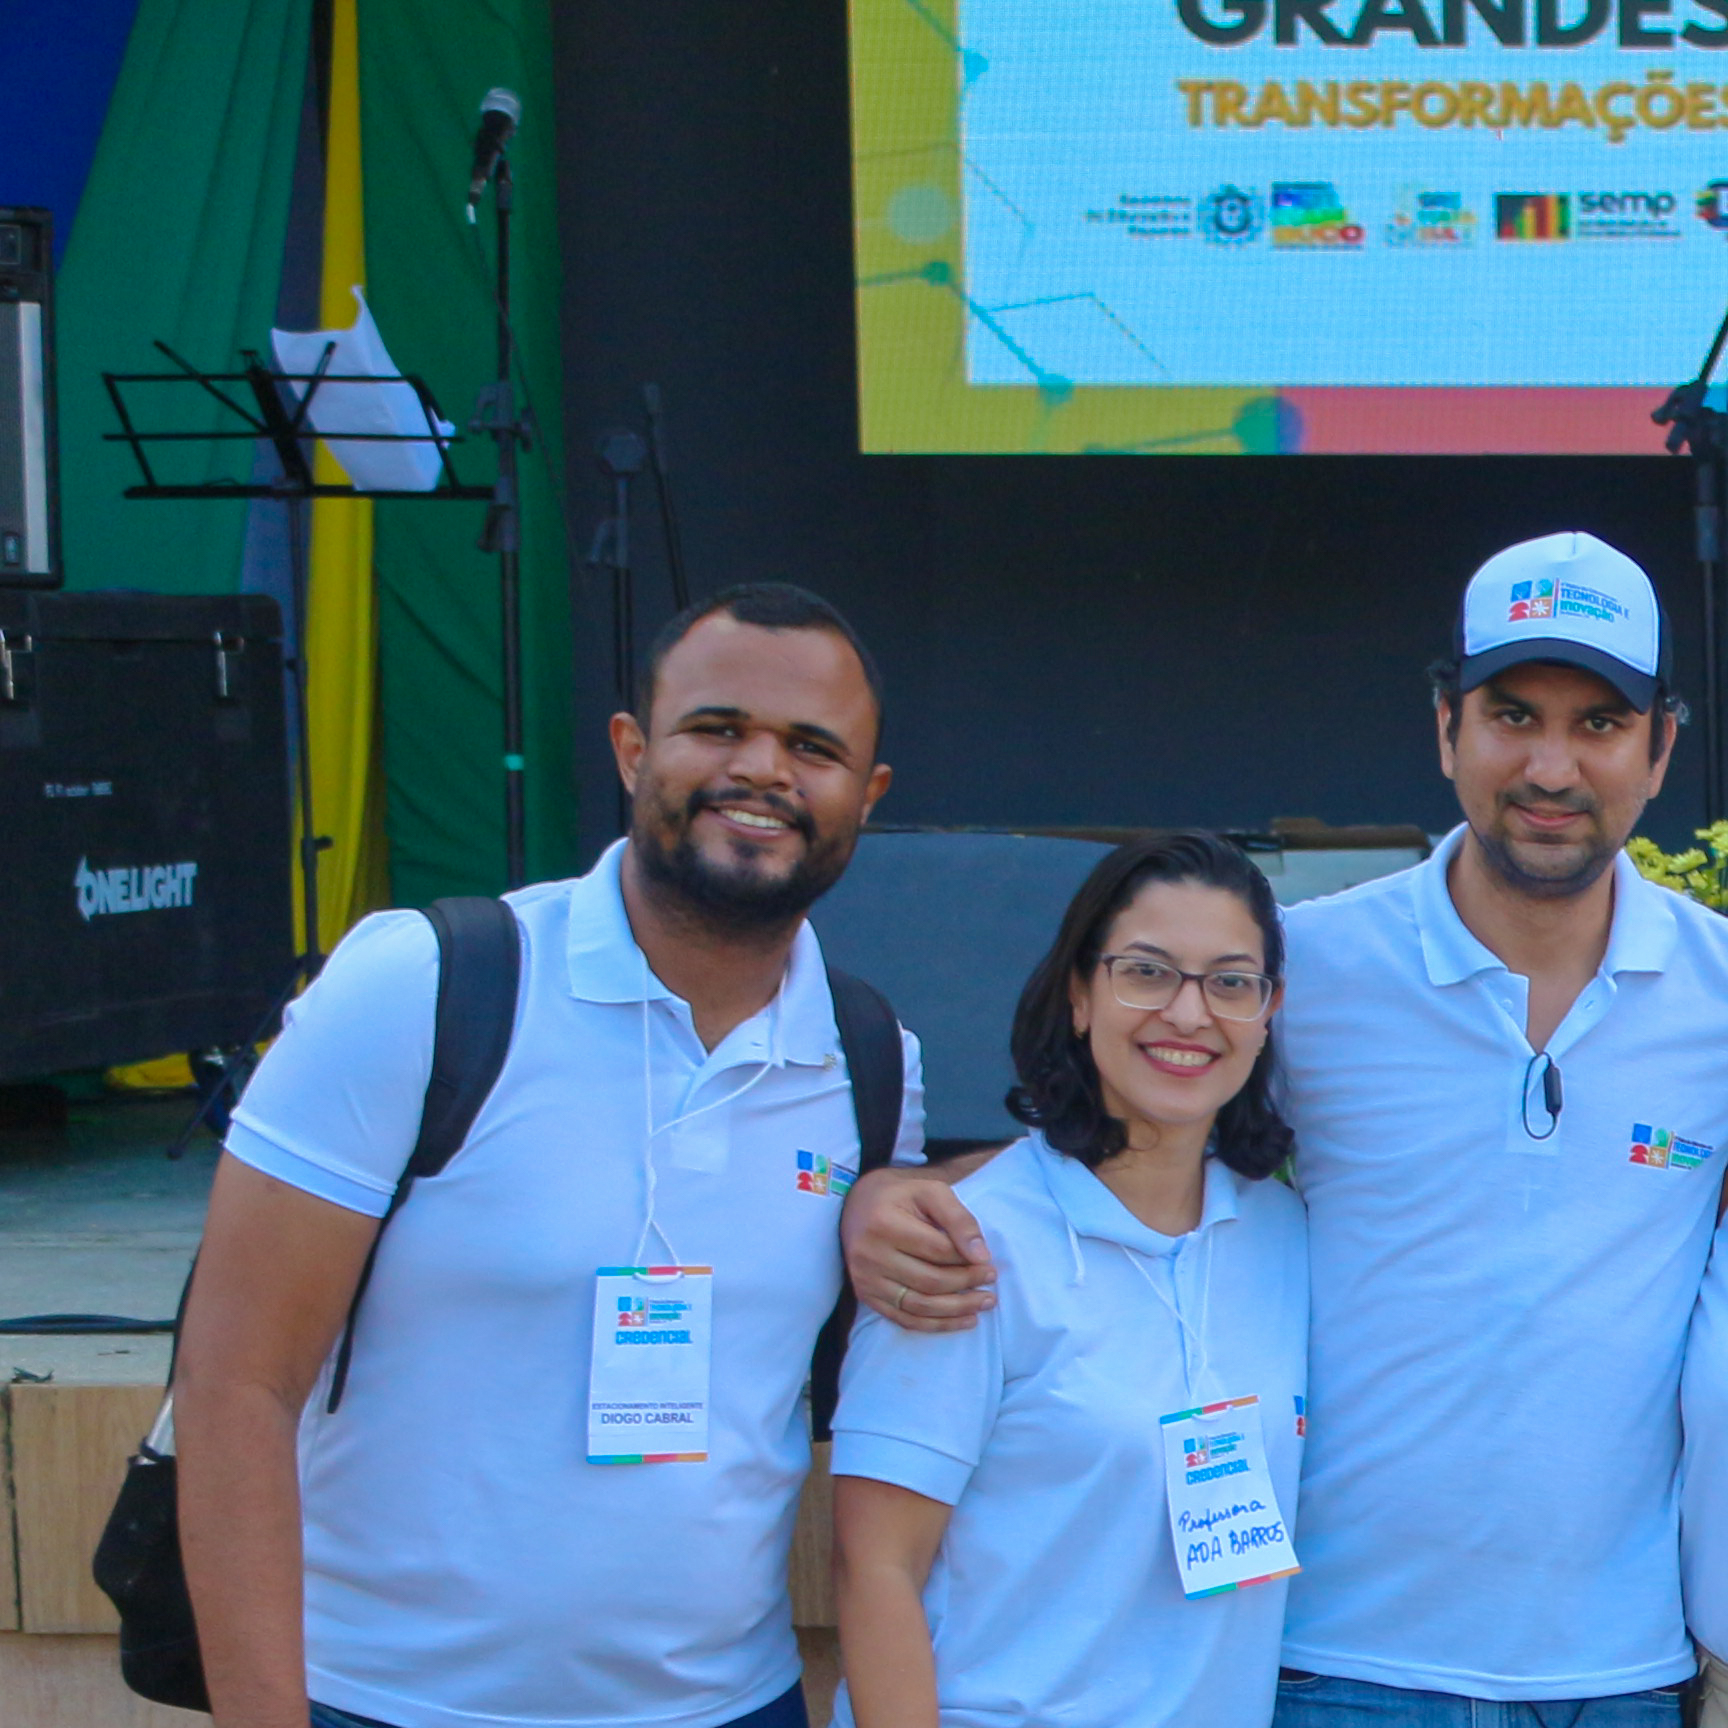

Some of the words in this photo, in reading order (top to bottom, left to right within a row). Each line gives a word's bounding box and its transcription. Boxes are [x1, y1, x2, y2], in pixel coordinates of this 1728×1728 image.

[74, 855, 198, 922] ONELIGHT
[601, 1412, 642, 1425] DIOGO
[645, 1412, 695, 1424] CABRAL
[1178, 1500, 1266, 1532] Professora
[1229, 1521, 1285, 1555] BARROS
